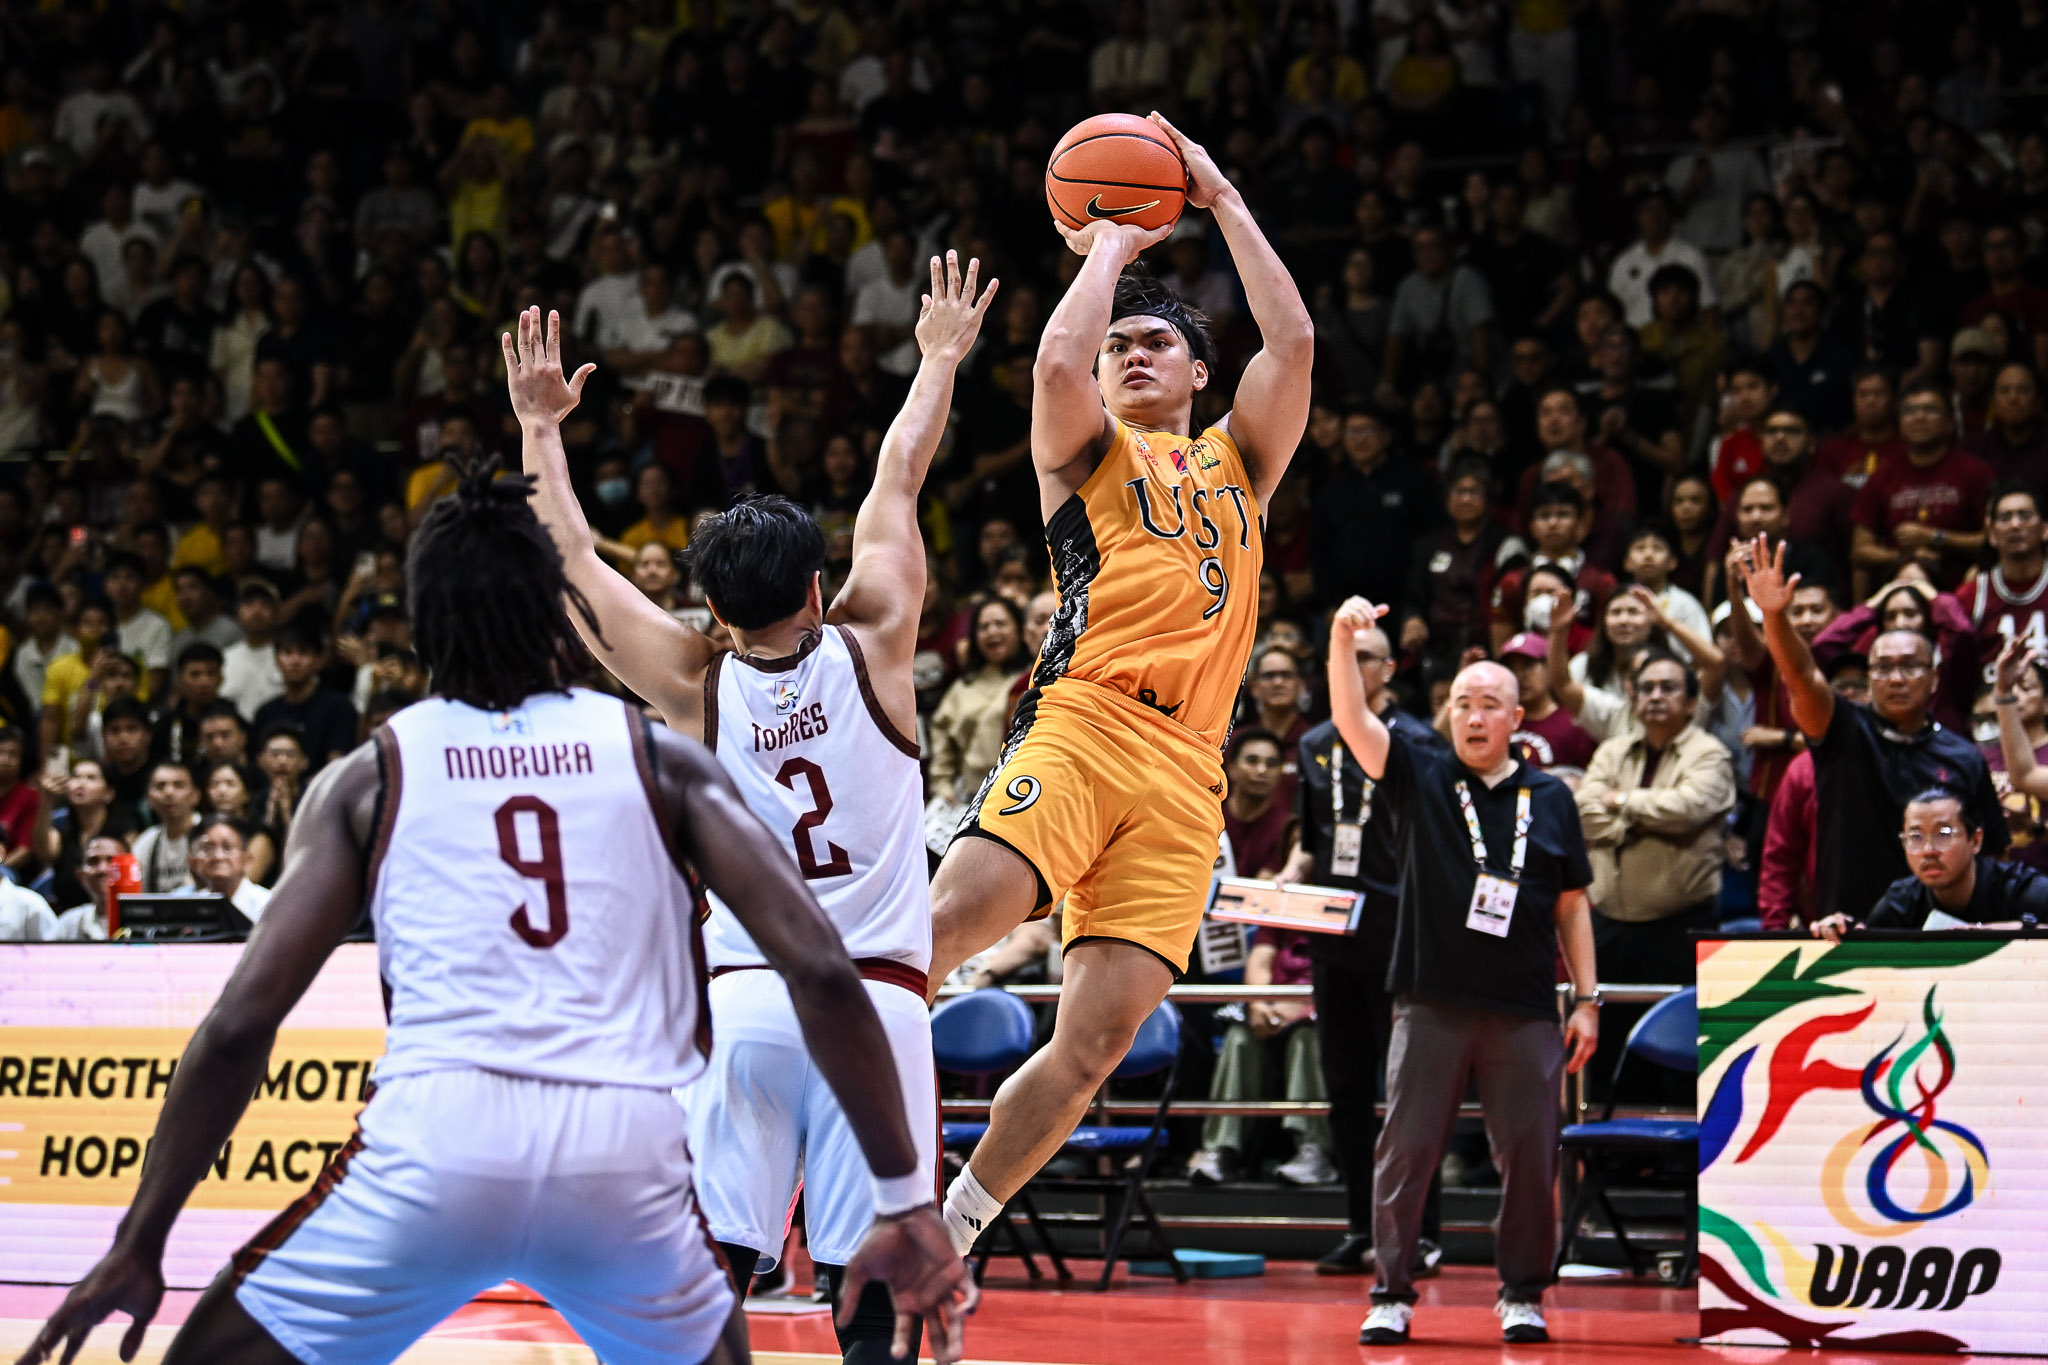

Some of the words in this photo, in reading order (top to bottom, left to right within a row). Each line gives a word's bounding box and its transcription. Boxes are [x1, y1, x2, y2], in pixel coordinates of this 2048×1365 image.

[1125, 477, 1250, 551] UST
[1198, 556, 1230, 621] 9
[751, 701, 829, 752] TORRES
[445, 743, 593, 779] NNORUKA
[774, 756, 853, 880] 2
[998, 775, 1042, 816] 9
[494, 795, 568, 948] 9
[0, 1056, 178, 1099] RENGTH
[40, 1136, 154, 1178] HOP
[245, 1140, 343, 1183] ACT
[1809, 1243, 2002, 1311] UAAP
